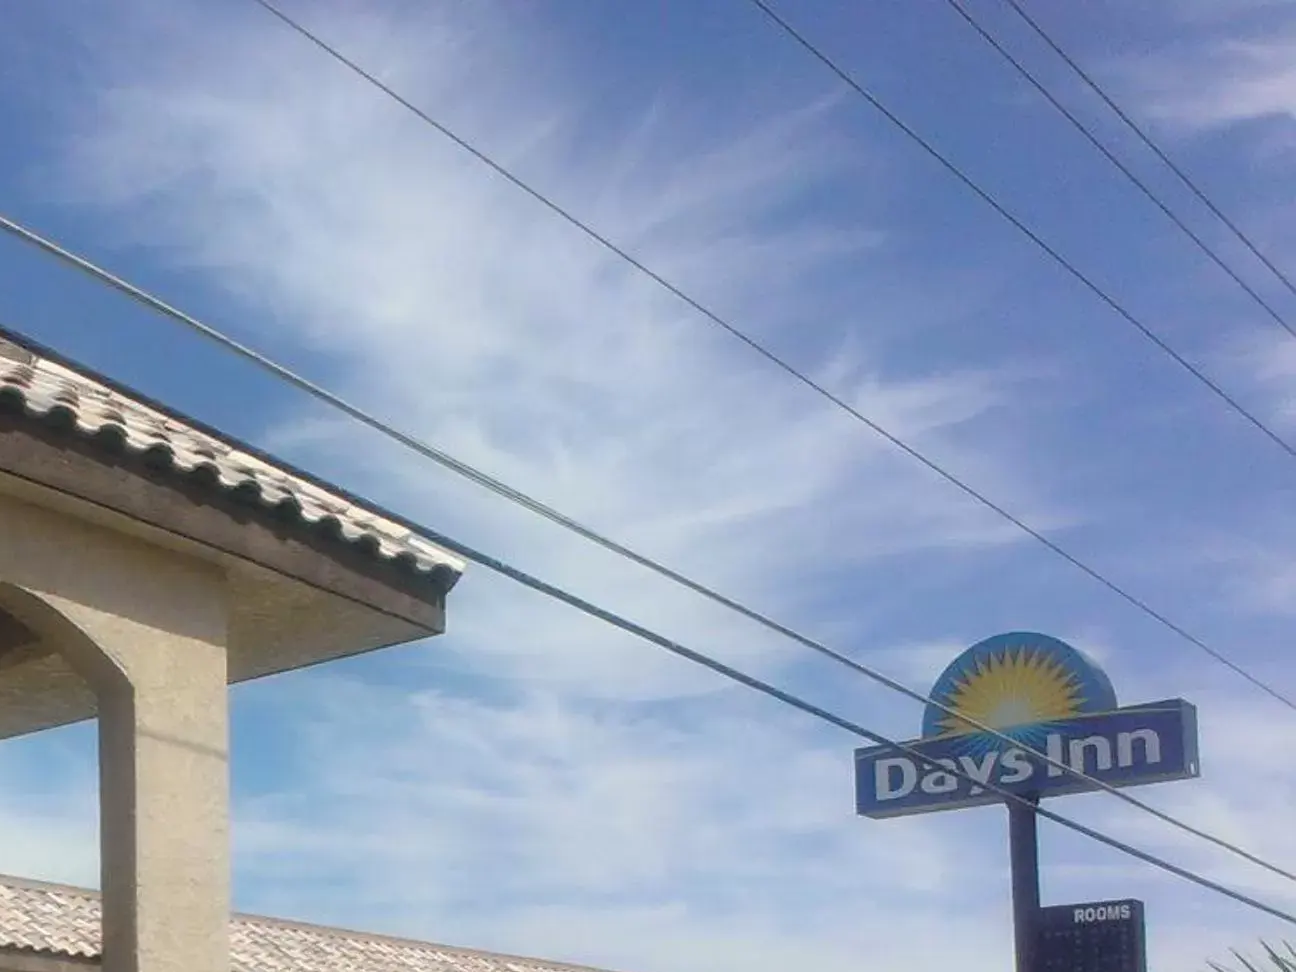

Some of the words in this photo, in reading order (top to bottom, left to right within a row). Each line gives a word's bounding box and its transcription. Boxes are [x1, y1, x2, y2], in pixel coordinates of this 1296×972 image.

[874, 748, 1034, 801] Days
[1046, 728, 1161, 777] Inn
[1073, 904, 1131, 923] ROOMS
